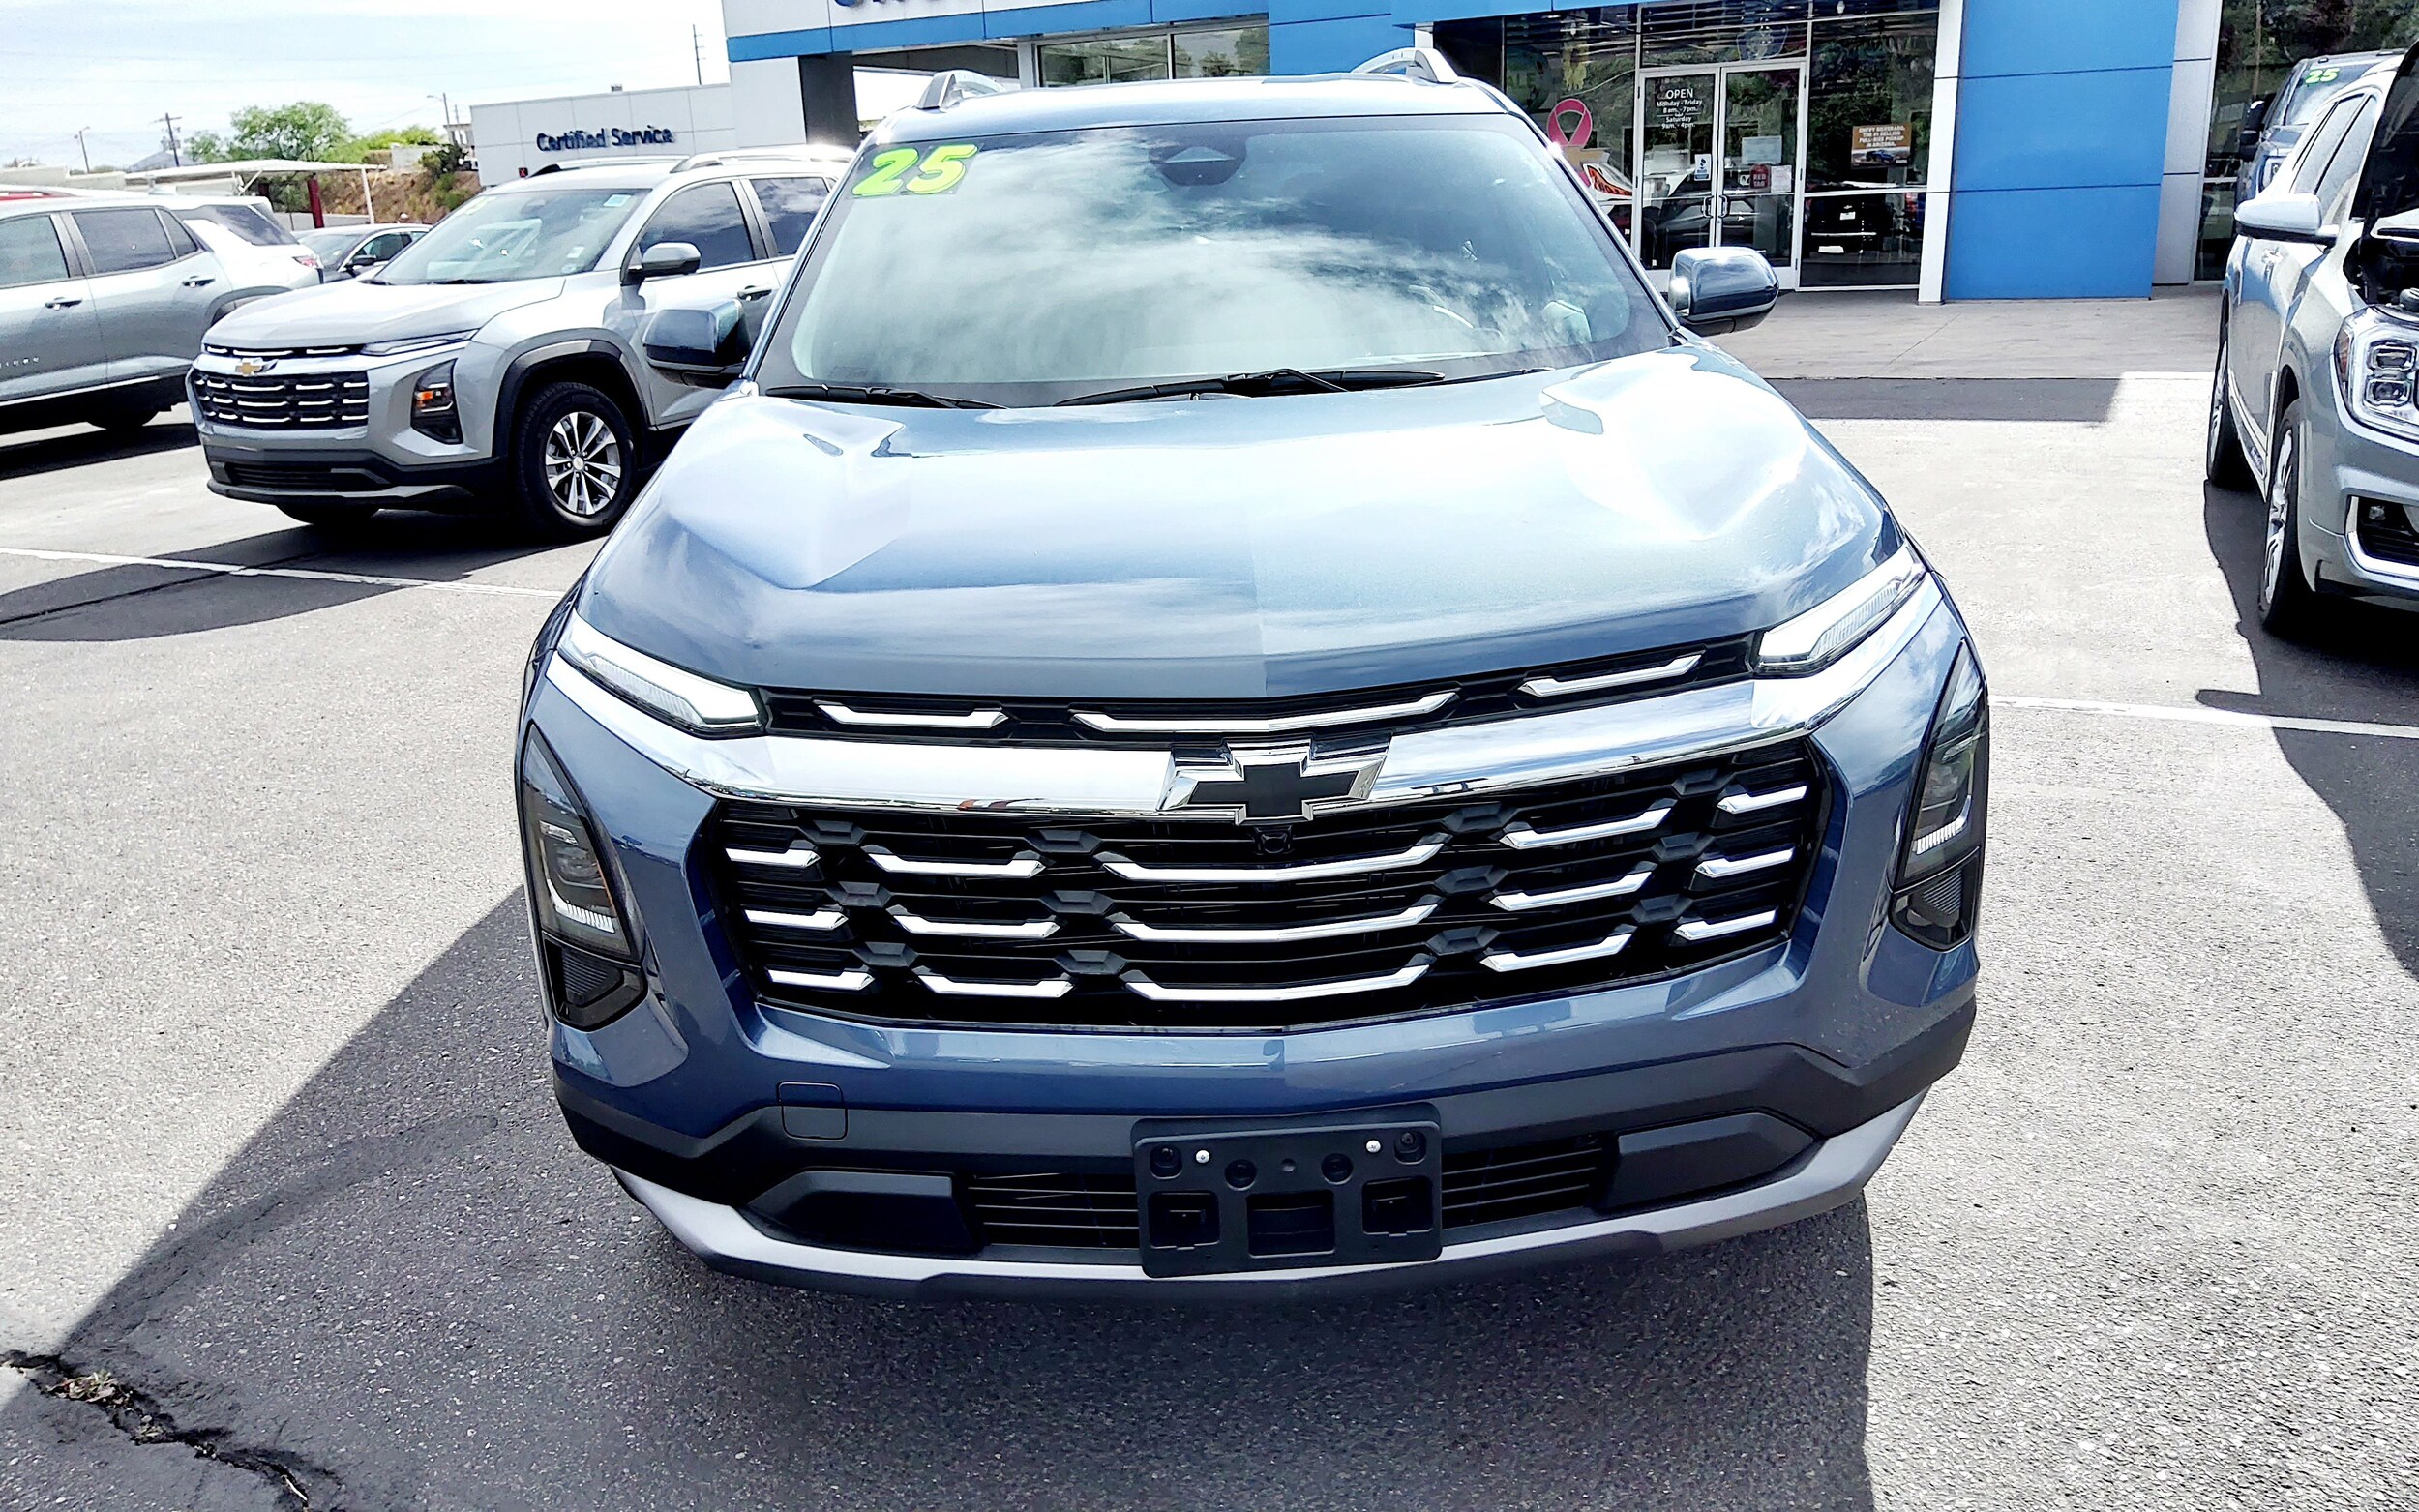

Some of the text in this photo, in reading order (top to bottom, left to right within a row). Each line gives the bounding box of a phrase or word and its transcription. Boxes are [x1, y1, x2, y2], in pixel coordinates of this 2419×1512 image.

[2305, 68, 2340, 84] 25
[1666, 88, 1693, 99] OPEN
[536, 125, 673, 151] Certified Service
[852, 144, 978, 196] 25
